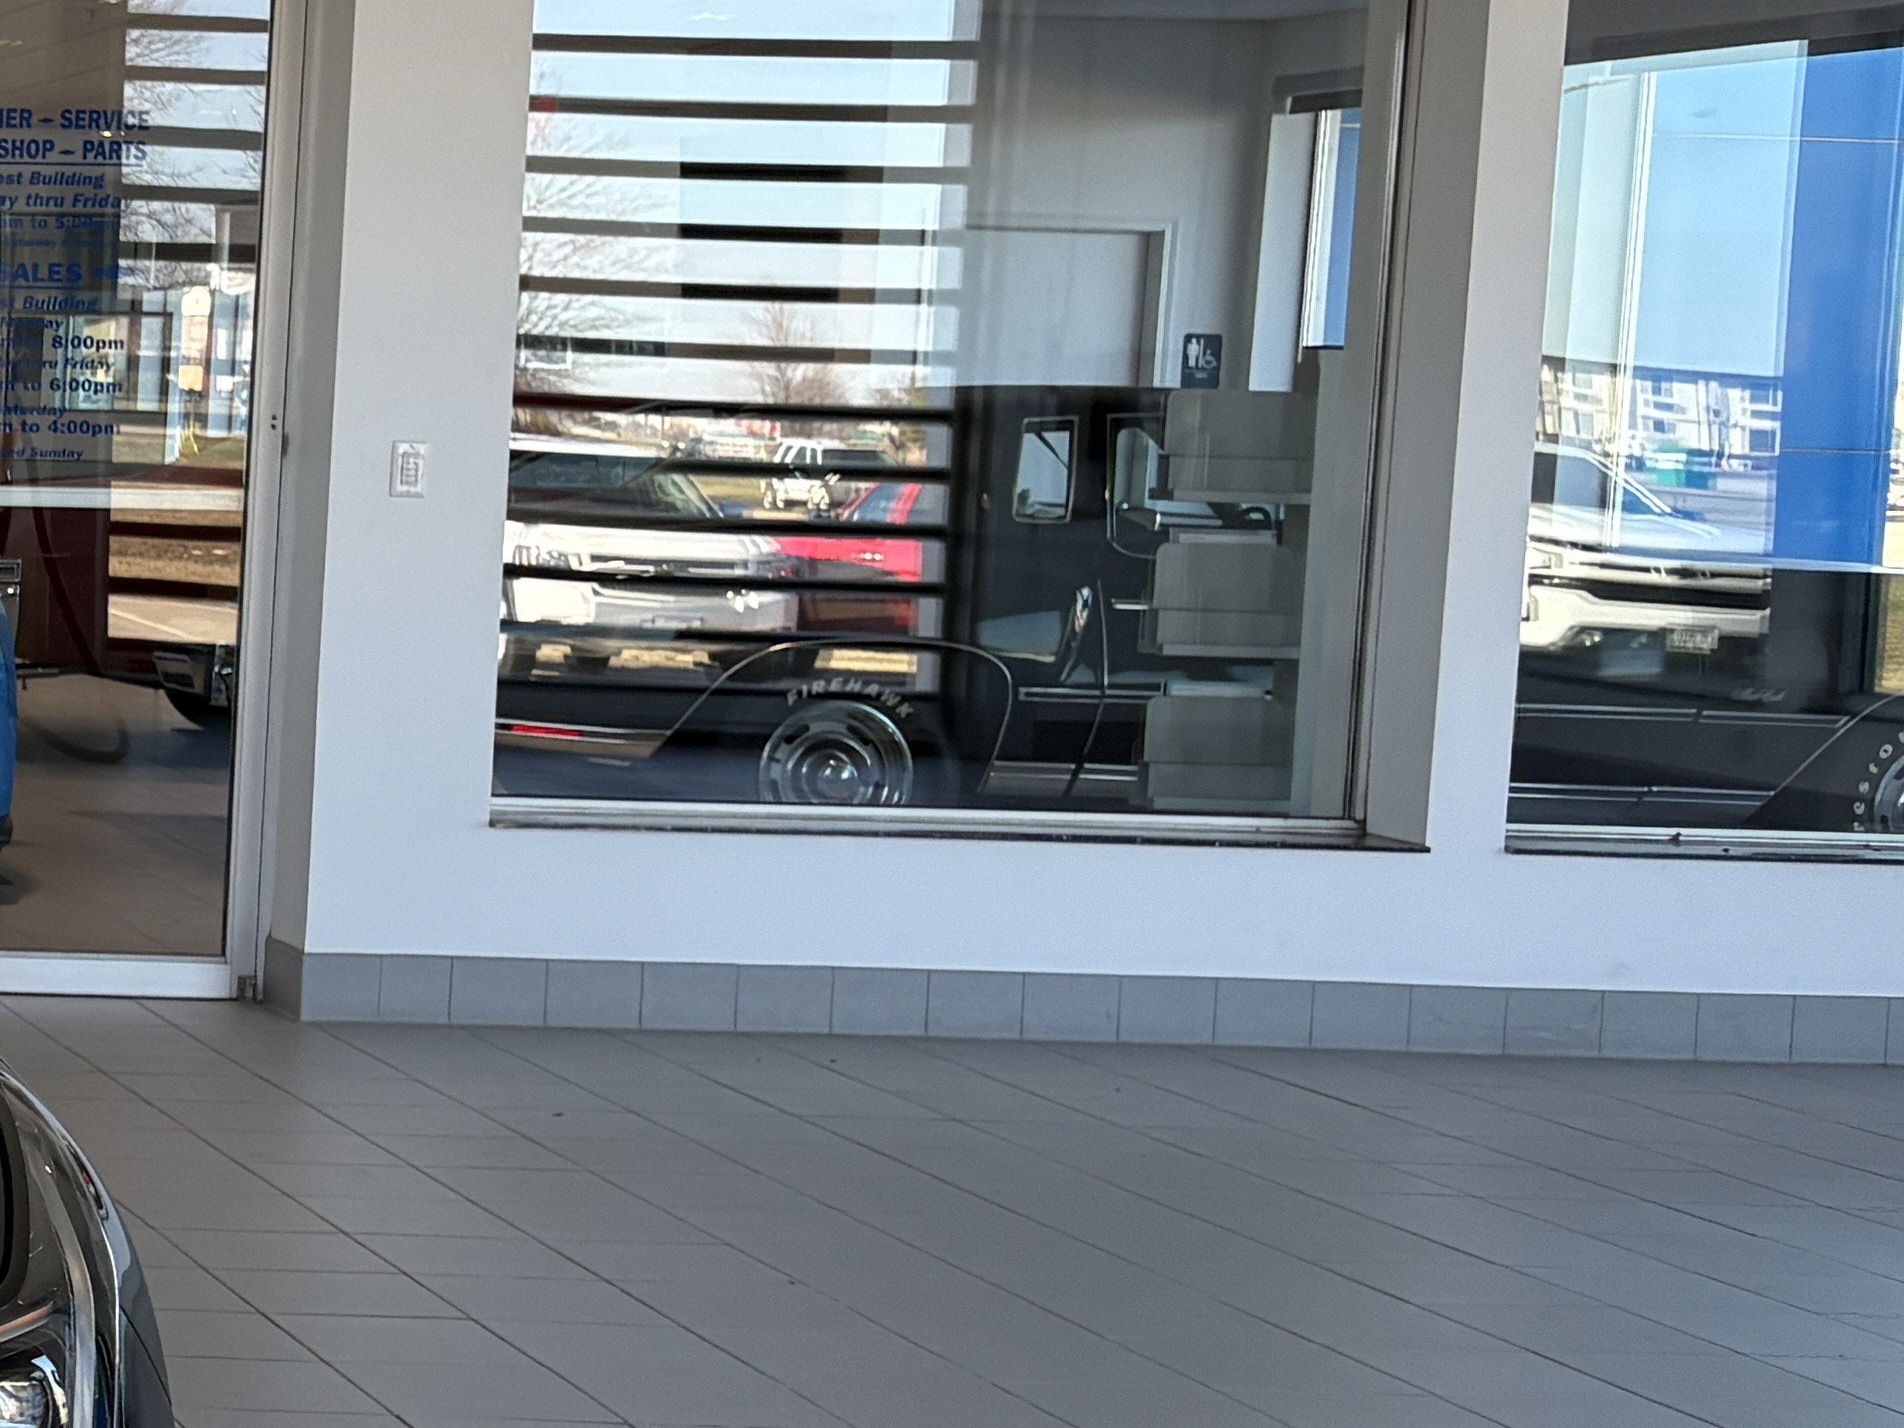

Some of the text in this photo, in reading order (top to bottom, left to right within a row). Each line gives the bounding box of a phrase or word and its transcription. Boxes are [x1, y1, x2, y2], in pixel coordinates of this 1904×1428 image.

[60, 108, 152, 131] SERVICE
[82, 139, 149, 162] PARTS
[29, 172, 105, 190] Building
[25, 192, 65, 209] thru
[71, 193, 133, 212] Frida
[51, 335, 124, 352] 8:00pm
[49, 377, 123, 395] 6:00pm
[21, 419, 40, 434] to
[786, 677, 914, 718] FIREHAWK
